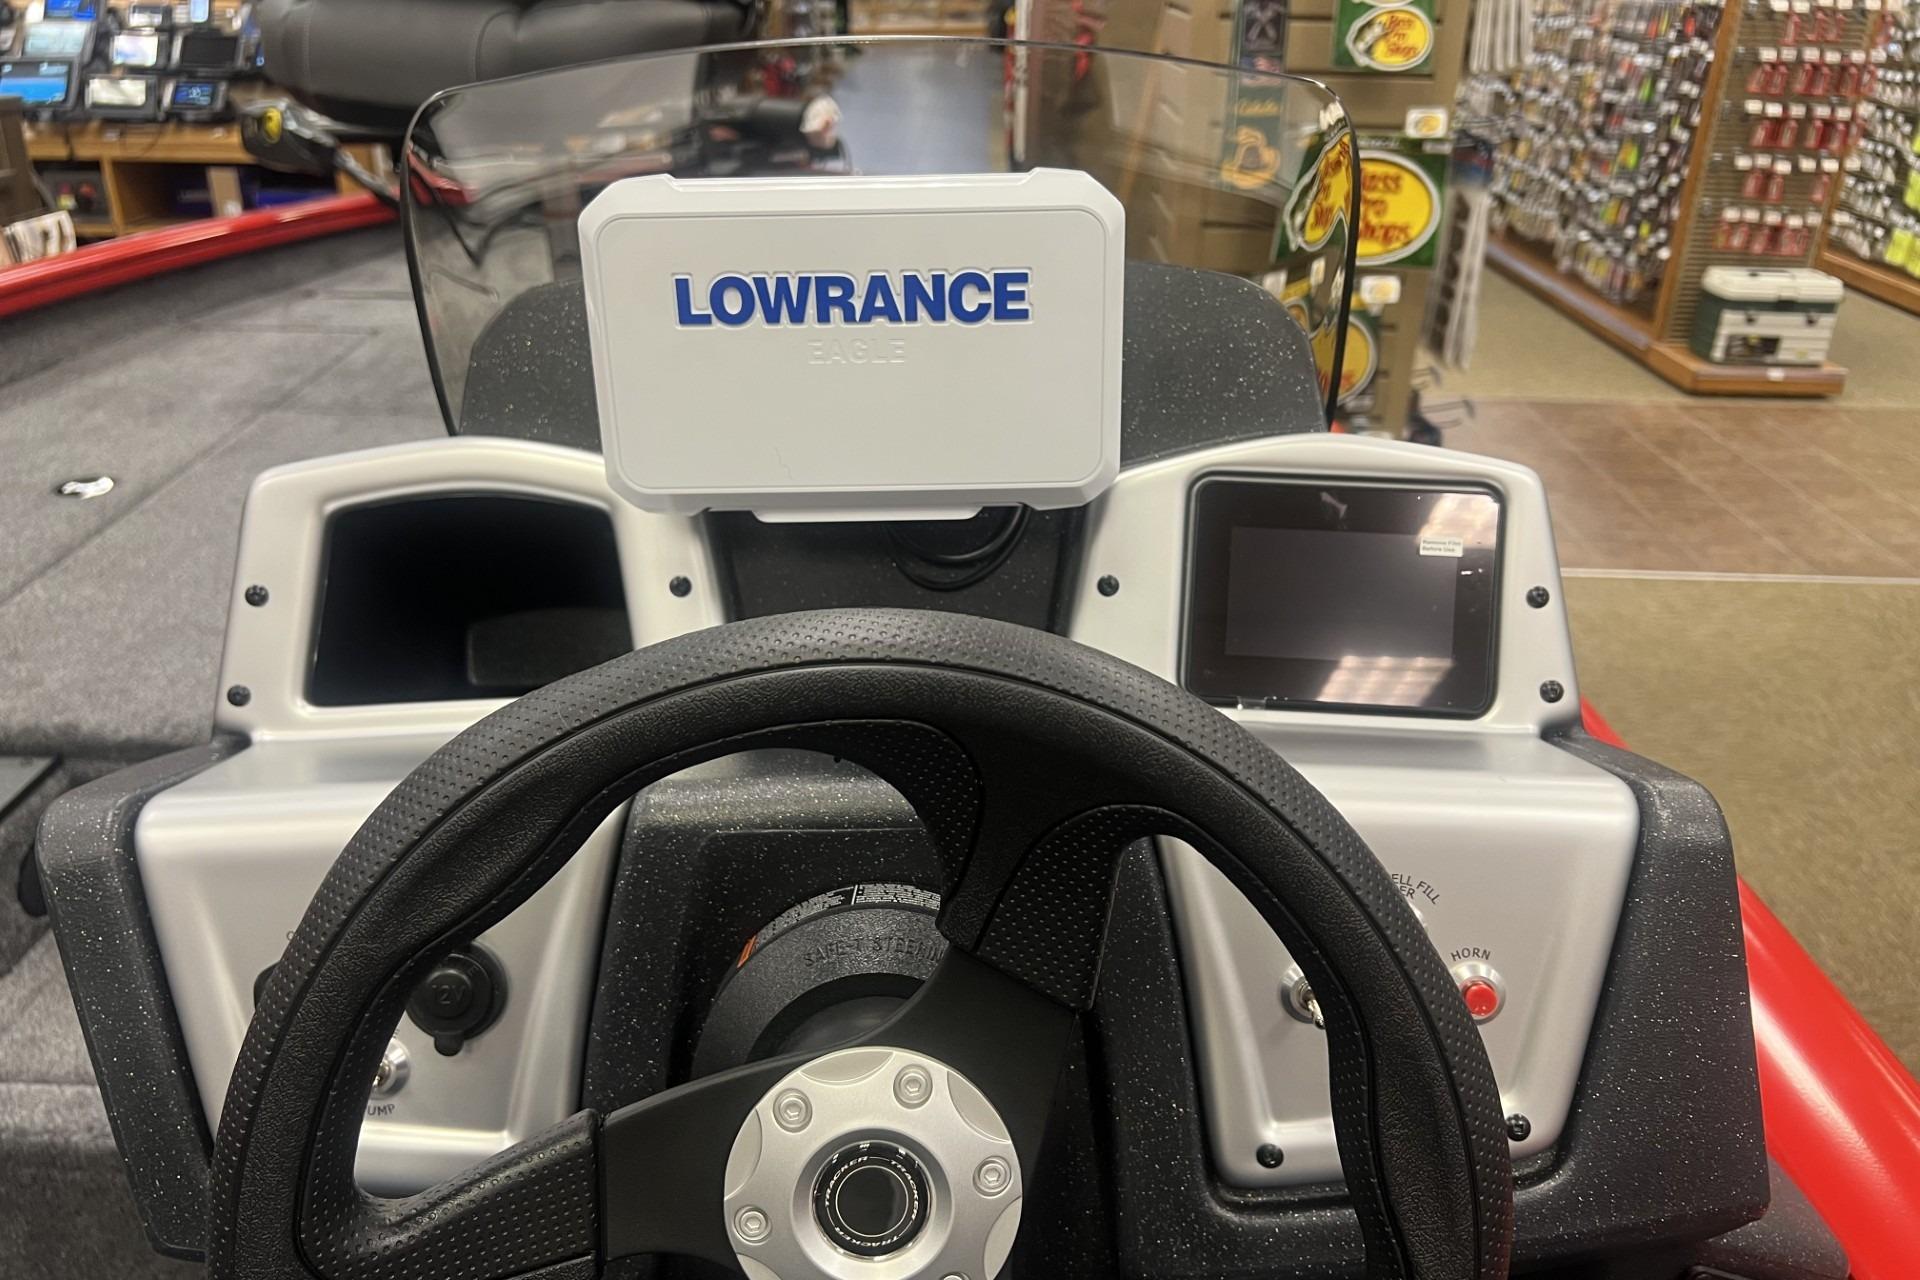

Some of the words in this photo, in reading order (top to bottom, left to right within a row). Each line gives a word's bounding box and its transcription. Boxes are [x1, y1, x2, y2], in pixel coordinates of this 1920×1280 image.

[673, 269, 1032, 328] LOWRANCE
[808, 337, 906, 365] EAGLE
[1391, 873, 1413, 887] ELL
[1416, 880, 1441, 905] FILL
[872, 936, 946, 962] STEERIN
[1450, 947, 1491, 962] HORN
[366, 1103, 396, 1116] UMP
[824, 1155, 869, 1207] TRACKER
[890, 1159, 919, 1221] TRACKER
[834, 1226, 900, 1248] TRACKER
